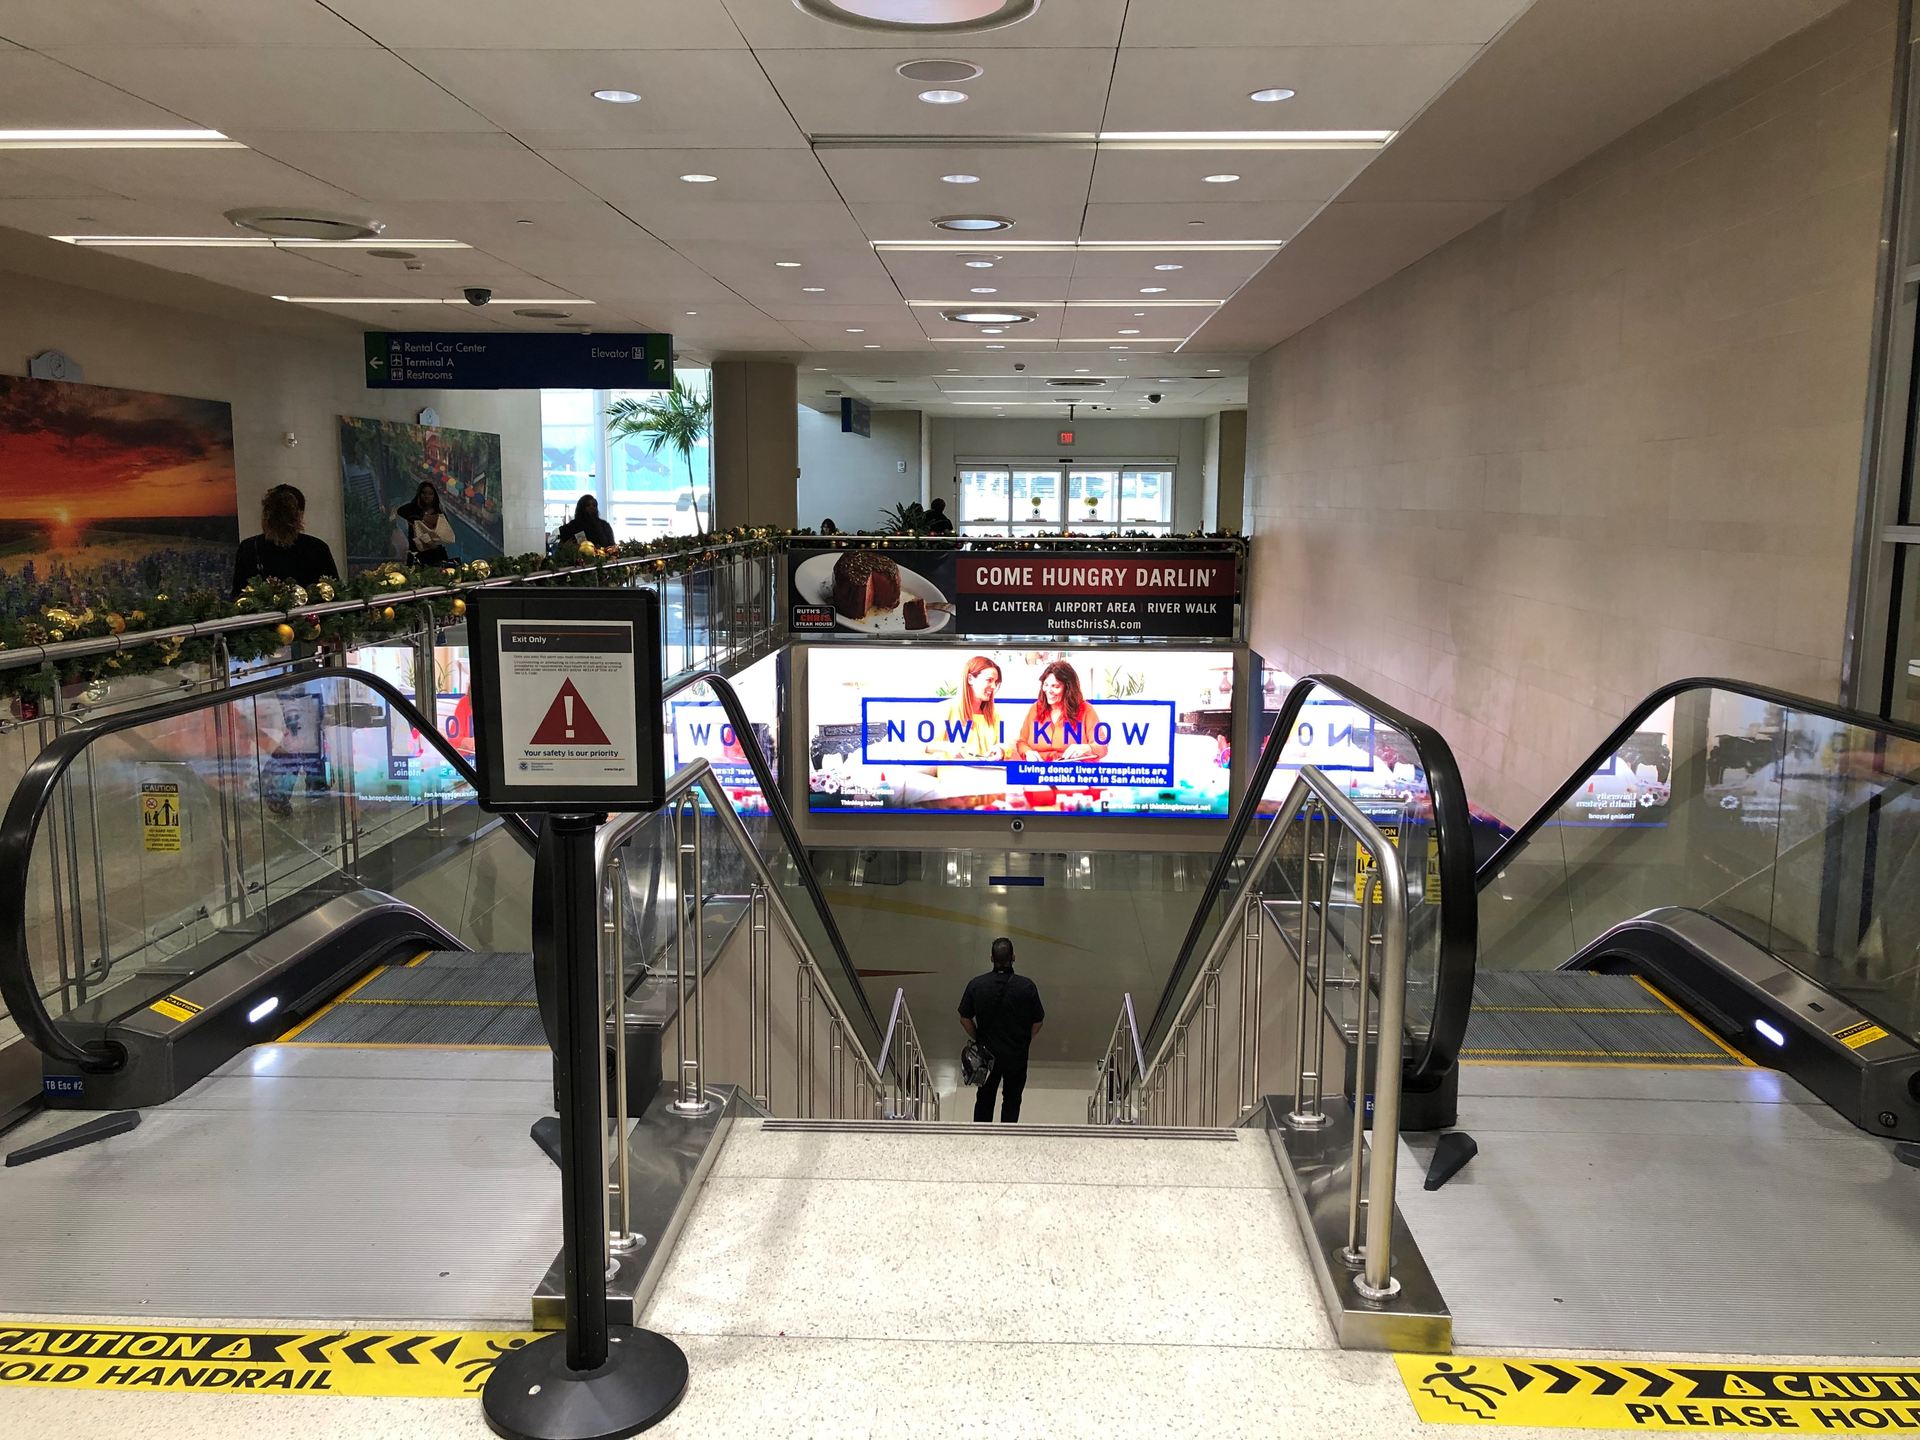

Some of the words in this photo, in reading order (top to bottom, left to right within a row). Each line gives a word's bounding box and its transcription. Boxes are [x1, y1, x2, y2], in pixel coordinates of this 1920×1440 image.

[404, 342, 433, 352] Rental
[435, 343, 451, 352] Car
[454, 343, 486, 353] Center
[591, 348, 629, 358] Elevator
[405, 357, 444, 367] Terminal
[446, 358, 454, 367] A
[406, 370, 453, 379] Restrooms
[1061, 433, 1073, 443] EXIT
[976, 566, 1033, 587] COME
[1042, 567, 1127, 588] HUNGRY
[1135, 568, 1217, 588] DARLIN'
[975, 602, 988, 612] LA
[991, 602, 1044, 613] CANTERA
[1055, 602, 1103, 613] AIRPORT
[1106, 603, 1136, 613] AREA
[1147, 603, 1181, 613] RIVER
[1185, 603, 1217, 614] WALK
[800, 614, 831, 622] CHRIS
[1047, 618, 1141, 630] RuthsChrisSA.com
[512, 635, 527, 643] Exit
[528, 635, 547, 645] Only
[887, 720, 971, 743] NOW
[1000, 721, 1004, 743] I
[1034, 721, 1150, 746] KNOW
[542, 750, 566, 758] safety
[590, 750, 618, 758] priority
[1018, 765, 1046, 774] Living
[1048, 766, 1073, 774] donor
[1075, 766, 1096, 774] liver
[1098, 766, 1150, 776] transplants
[1038, 774, 1075, 784] possible
[1077, 775, 1098, 783] here
[1100, 775, 1108, 783] in
[1110, 776, 1128, 784] San
[1130, 776, 1167, 784] Antonio.
[840, 786, 866, 795] Health
[1150, 803, 1211, 812] thinkingbeyond.net
[166, 998, 199, 1012] CAUTION
[1838, 1022, 1872, 1038] CAUTION
[46, 1080, 56, 1090] TB
[58, 1080, 72, 1090] Esc
[74, 1081, 84, 1090] #2
[0, 1331, 210, 1359] CAUTION
[0, 1361, 89, 1382] OLD
[94, 1365, 334, 1390] HANDRAIL
[1625, 1403, 1799, 1428] PLEASE
